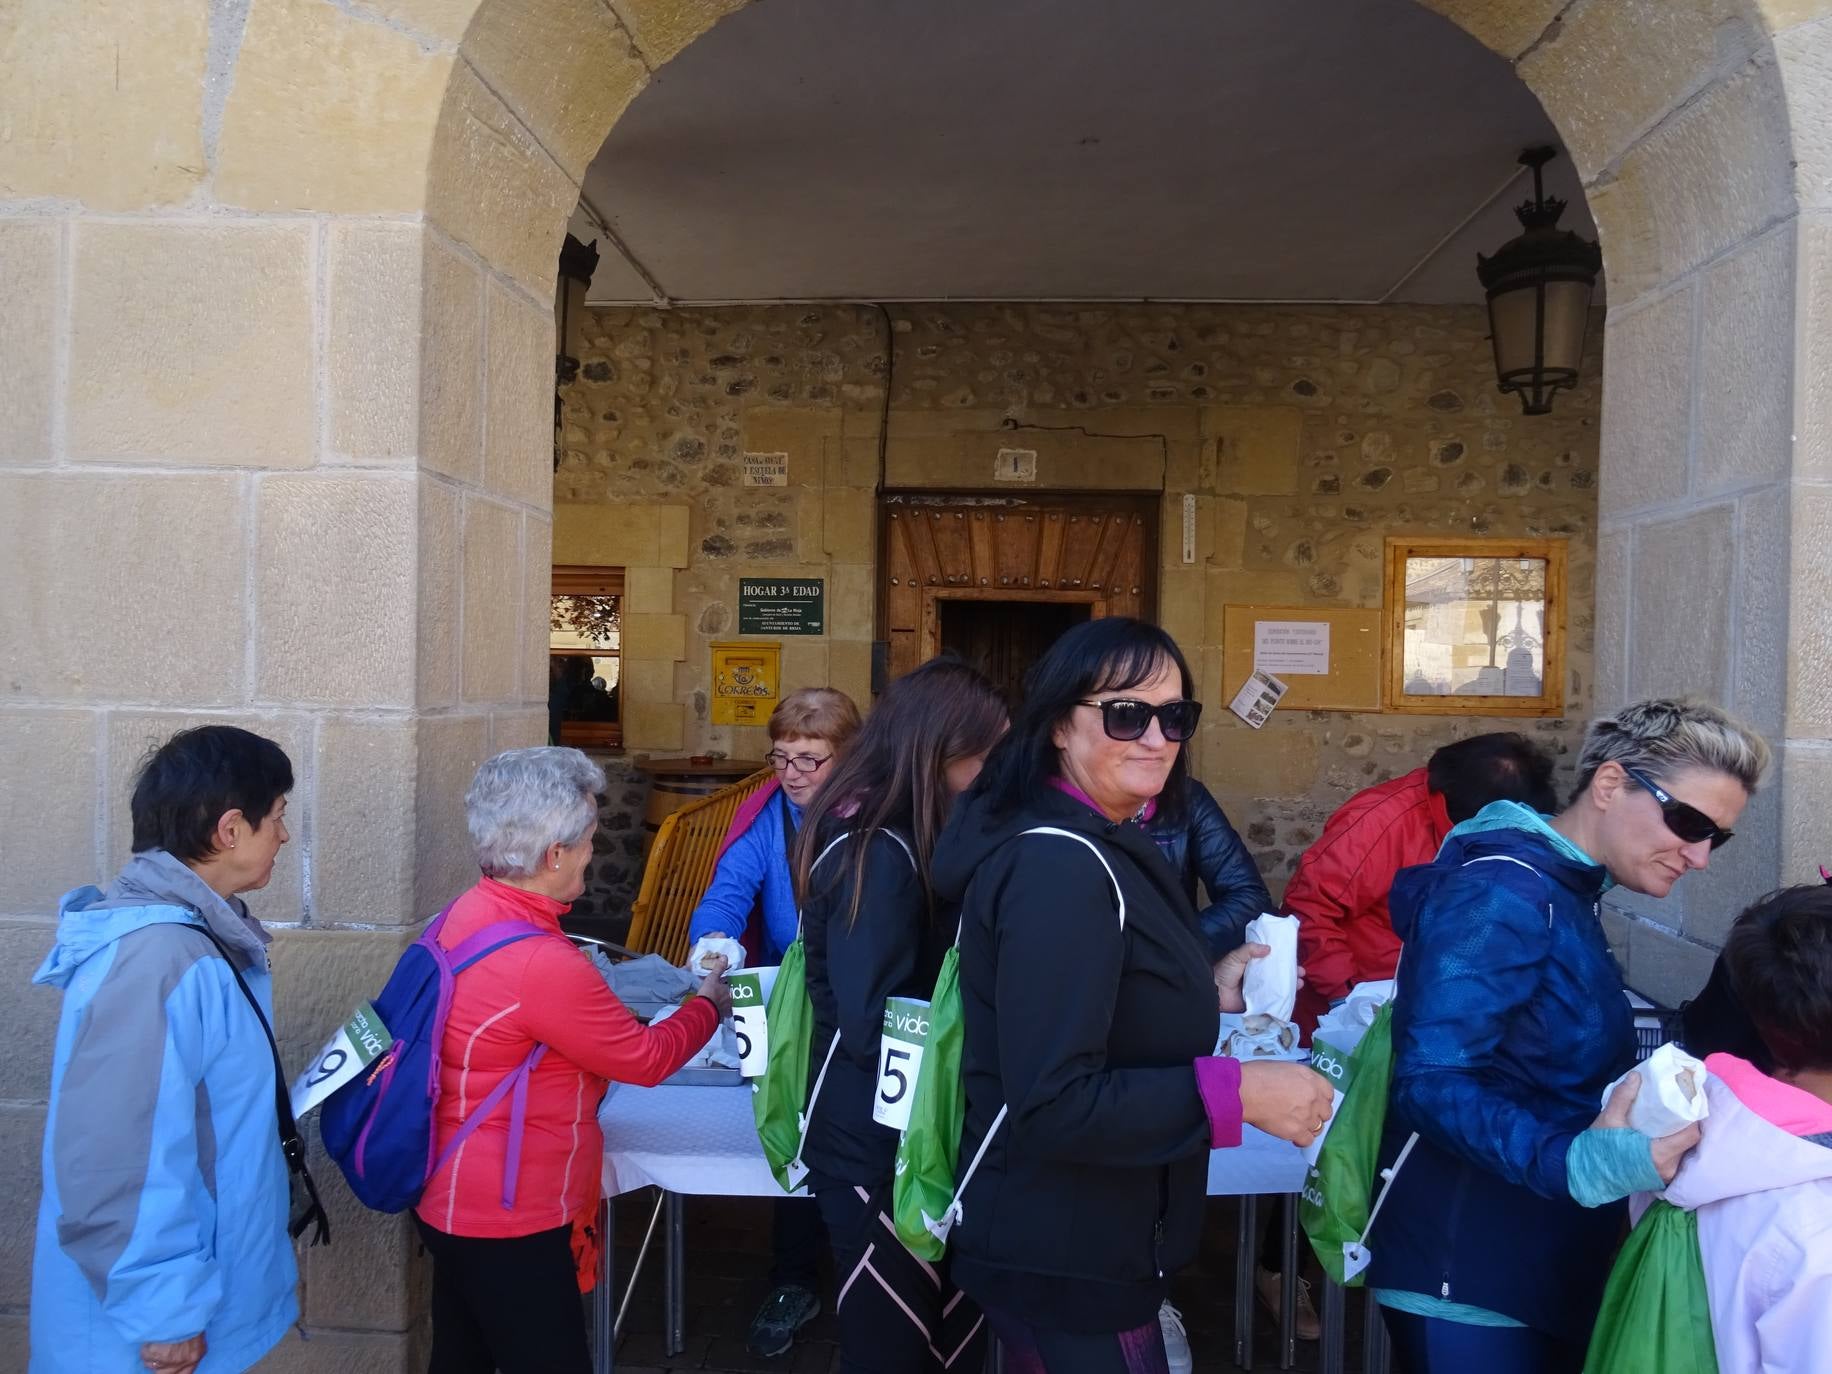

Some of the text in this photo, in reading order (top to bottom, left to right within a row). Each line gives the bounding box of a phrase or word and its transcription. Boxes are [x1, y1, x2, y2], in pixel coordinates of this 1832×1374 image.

[743, 585, 777, 596] HOGAR
[793, 586, 820, 597] EDAD
[730, 983, 753, 1000] ida
